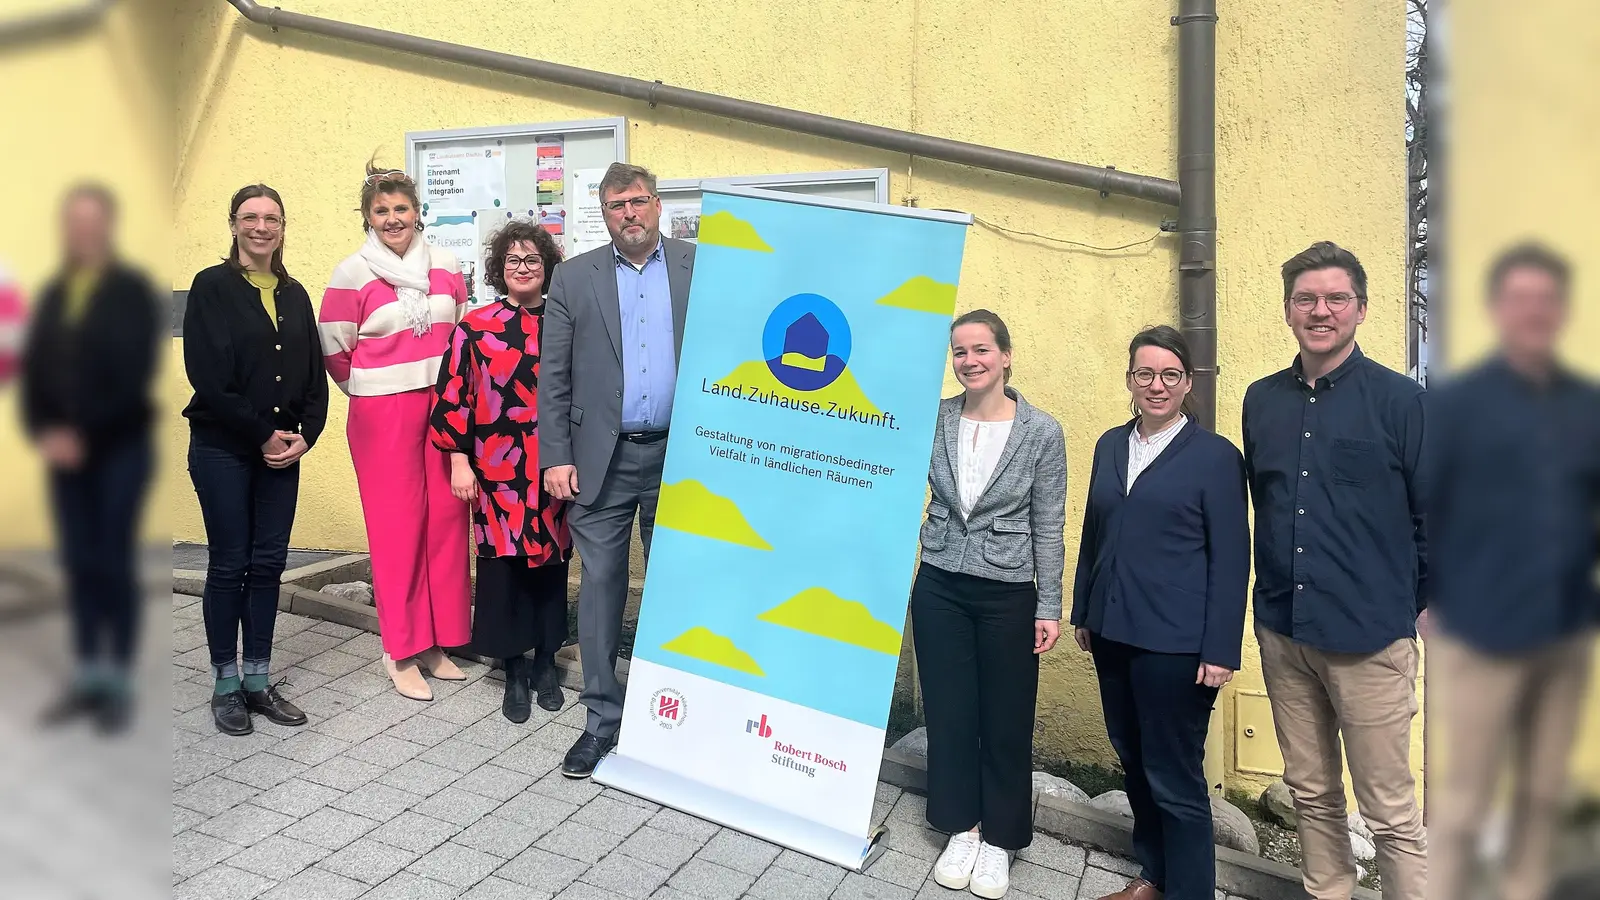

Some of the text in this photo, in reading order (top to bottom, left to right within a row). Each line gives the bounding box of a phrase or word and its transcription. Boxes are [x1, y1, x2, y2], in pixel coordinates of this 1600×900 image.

[427, 168, 460, 176] Ehrenamt
[427, 178, 454, 187] Bildung
[428, 187, 464, 196] Integration
[437, 238, 473, 247] FLEXHERO
[701, 377, 901, 431] Land.Zuhause.Zukunft.
[695, 425, 895, 477] Gestaltung von migrationsbedingter
[709, 445, 873, 489] Vielfalt in ländlichen Räumen
[659, 720, 673, 730] 2003
[773, 740, 847, 773] Robert Bosch
[771, 753, 816, 778] Stiftung
